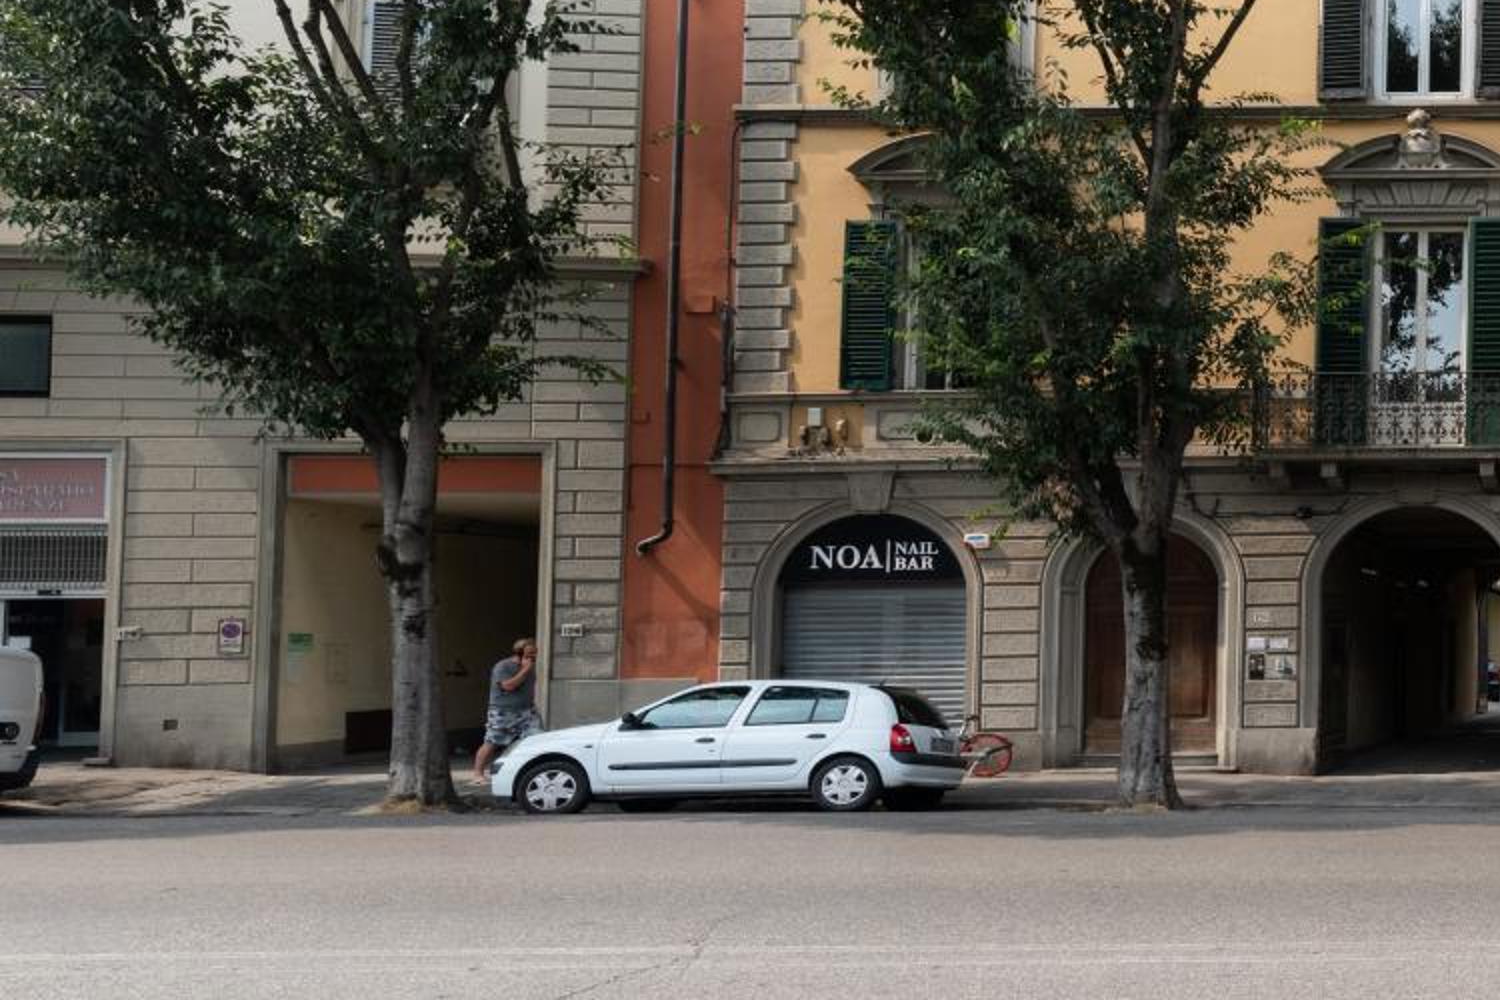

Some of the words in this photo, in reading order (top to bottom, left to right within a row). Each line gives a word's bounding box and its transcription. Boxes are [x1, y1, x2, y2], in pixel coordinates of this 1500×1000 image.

[895, 541, 938, 555] NAIL
[810, 545, 883, 568] NOA
[893, 556, 933, 571] BAR
